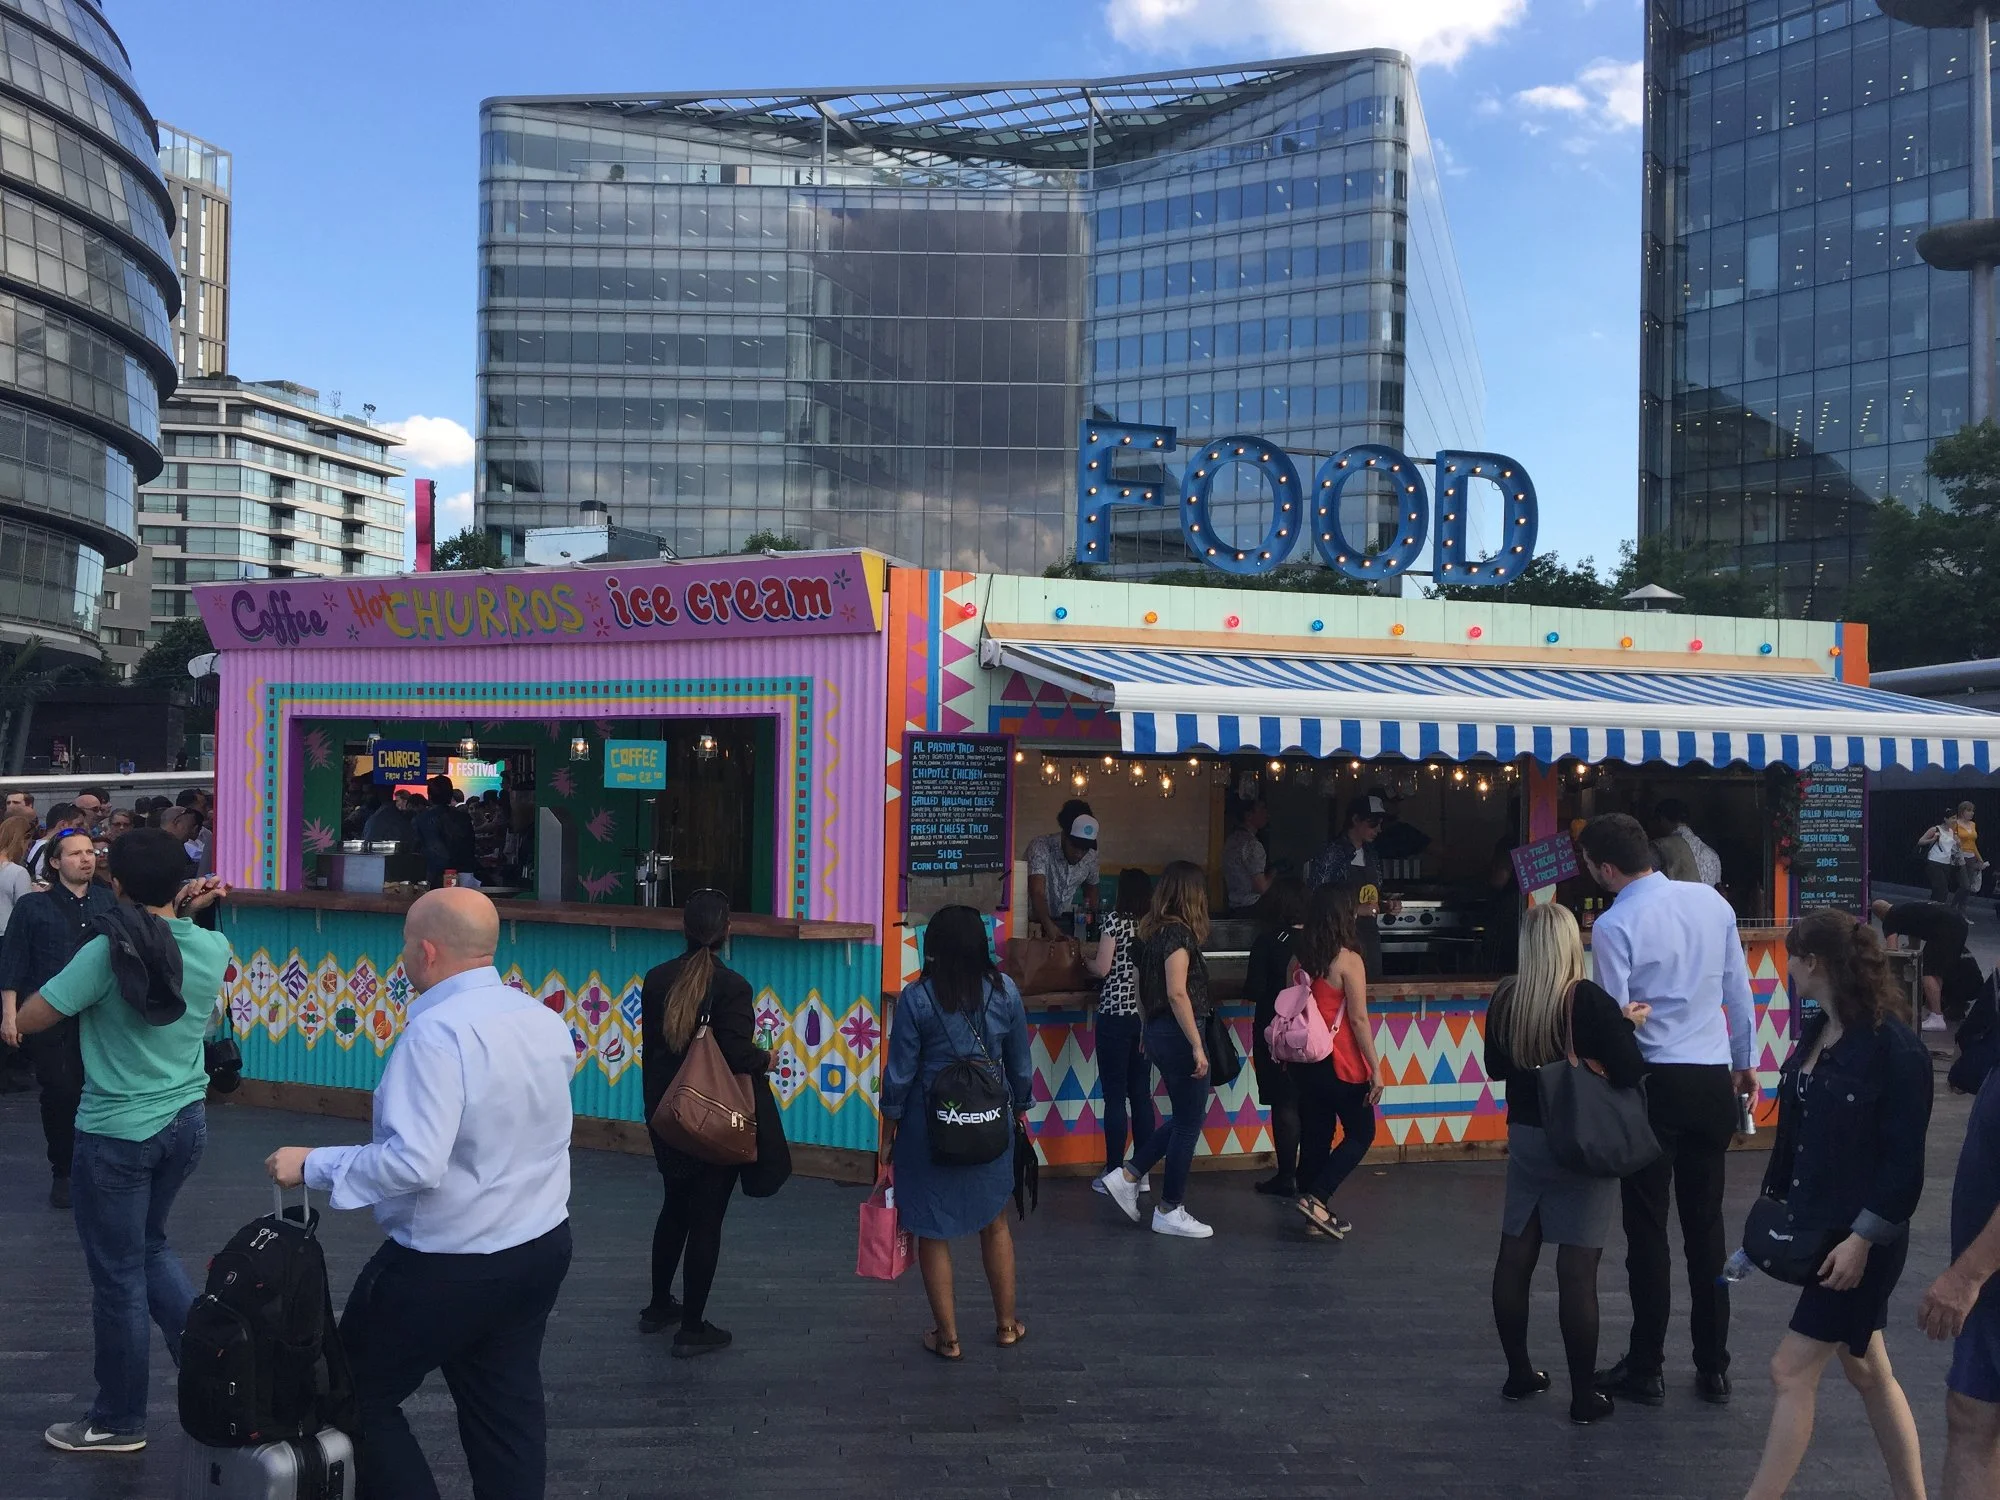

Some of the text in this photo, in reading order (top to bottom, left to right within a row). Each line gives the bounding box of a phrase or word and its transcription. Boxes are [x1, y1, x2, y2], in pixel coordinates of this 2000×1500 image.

[1077, 418, 1539, 585] FOOD
[231, 575, 834, 647] Coffee Hot CHURROS ice cream
[913, 741, 925, 753] AL
[927, 741, 956, 753] PASTOR
[956, 742, 975, 754] TACO
[378, 750, 421, 768] CHURROS
[610, 747, 658, 769] COFFEE
[385, 771, 400, 781] FROM
[456, 762, 500, 777] FESTIVAL
[912, 768, 949, 779] CHIPOTLE
[952, 768, 983, 781] CHICKEN
[911, 796, 938, 807] GRILLED
[974, 797, 995, 807] CHEESE
[1800, 809, 1821, 818] GRILLED
[910, 824, 989, 834] FRESH CHEESE TACO
[937, 849, 963, 859] SIDES
[1529, 843, 1549, 857] TACO
[911, 862, 932, 871] CORN
[933, 862, 943, 870] ON
[944, 861, 958, 870] COB
[1519, 865, 1527, 876] 2
[1532, 852, 1557, 870] TACOS
[1816, 858, 1839, 868] SIDES
[1522, 877, 1530, 889] 3
[1535, 866, 1559, 883] TACOS
